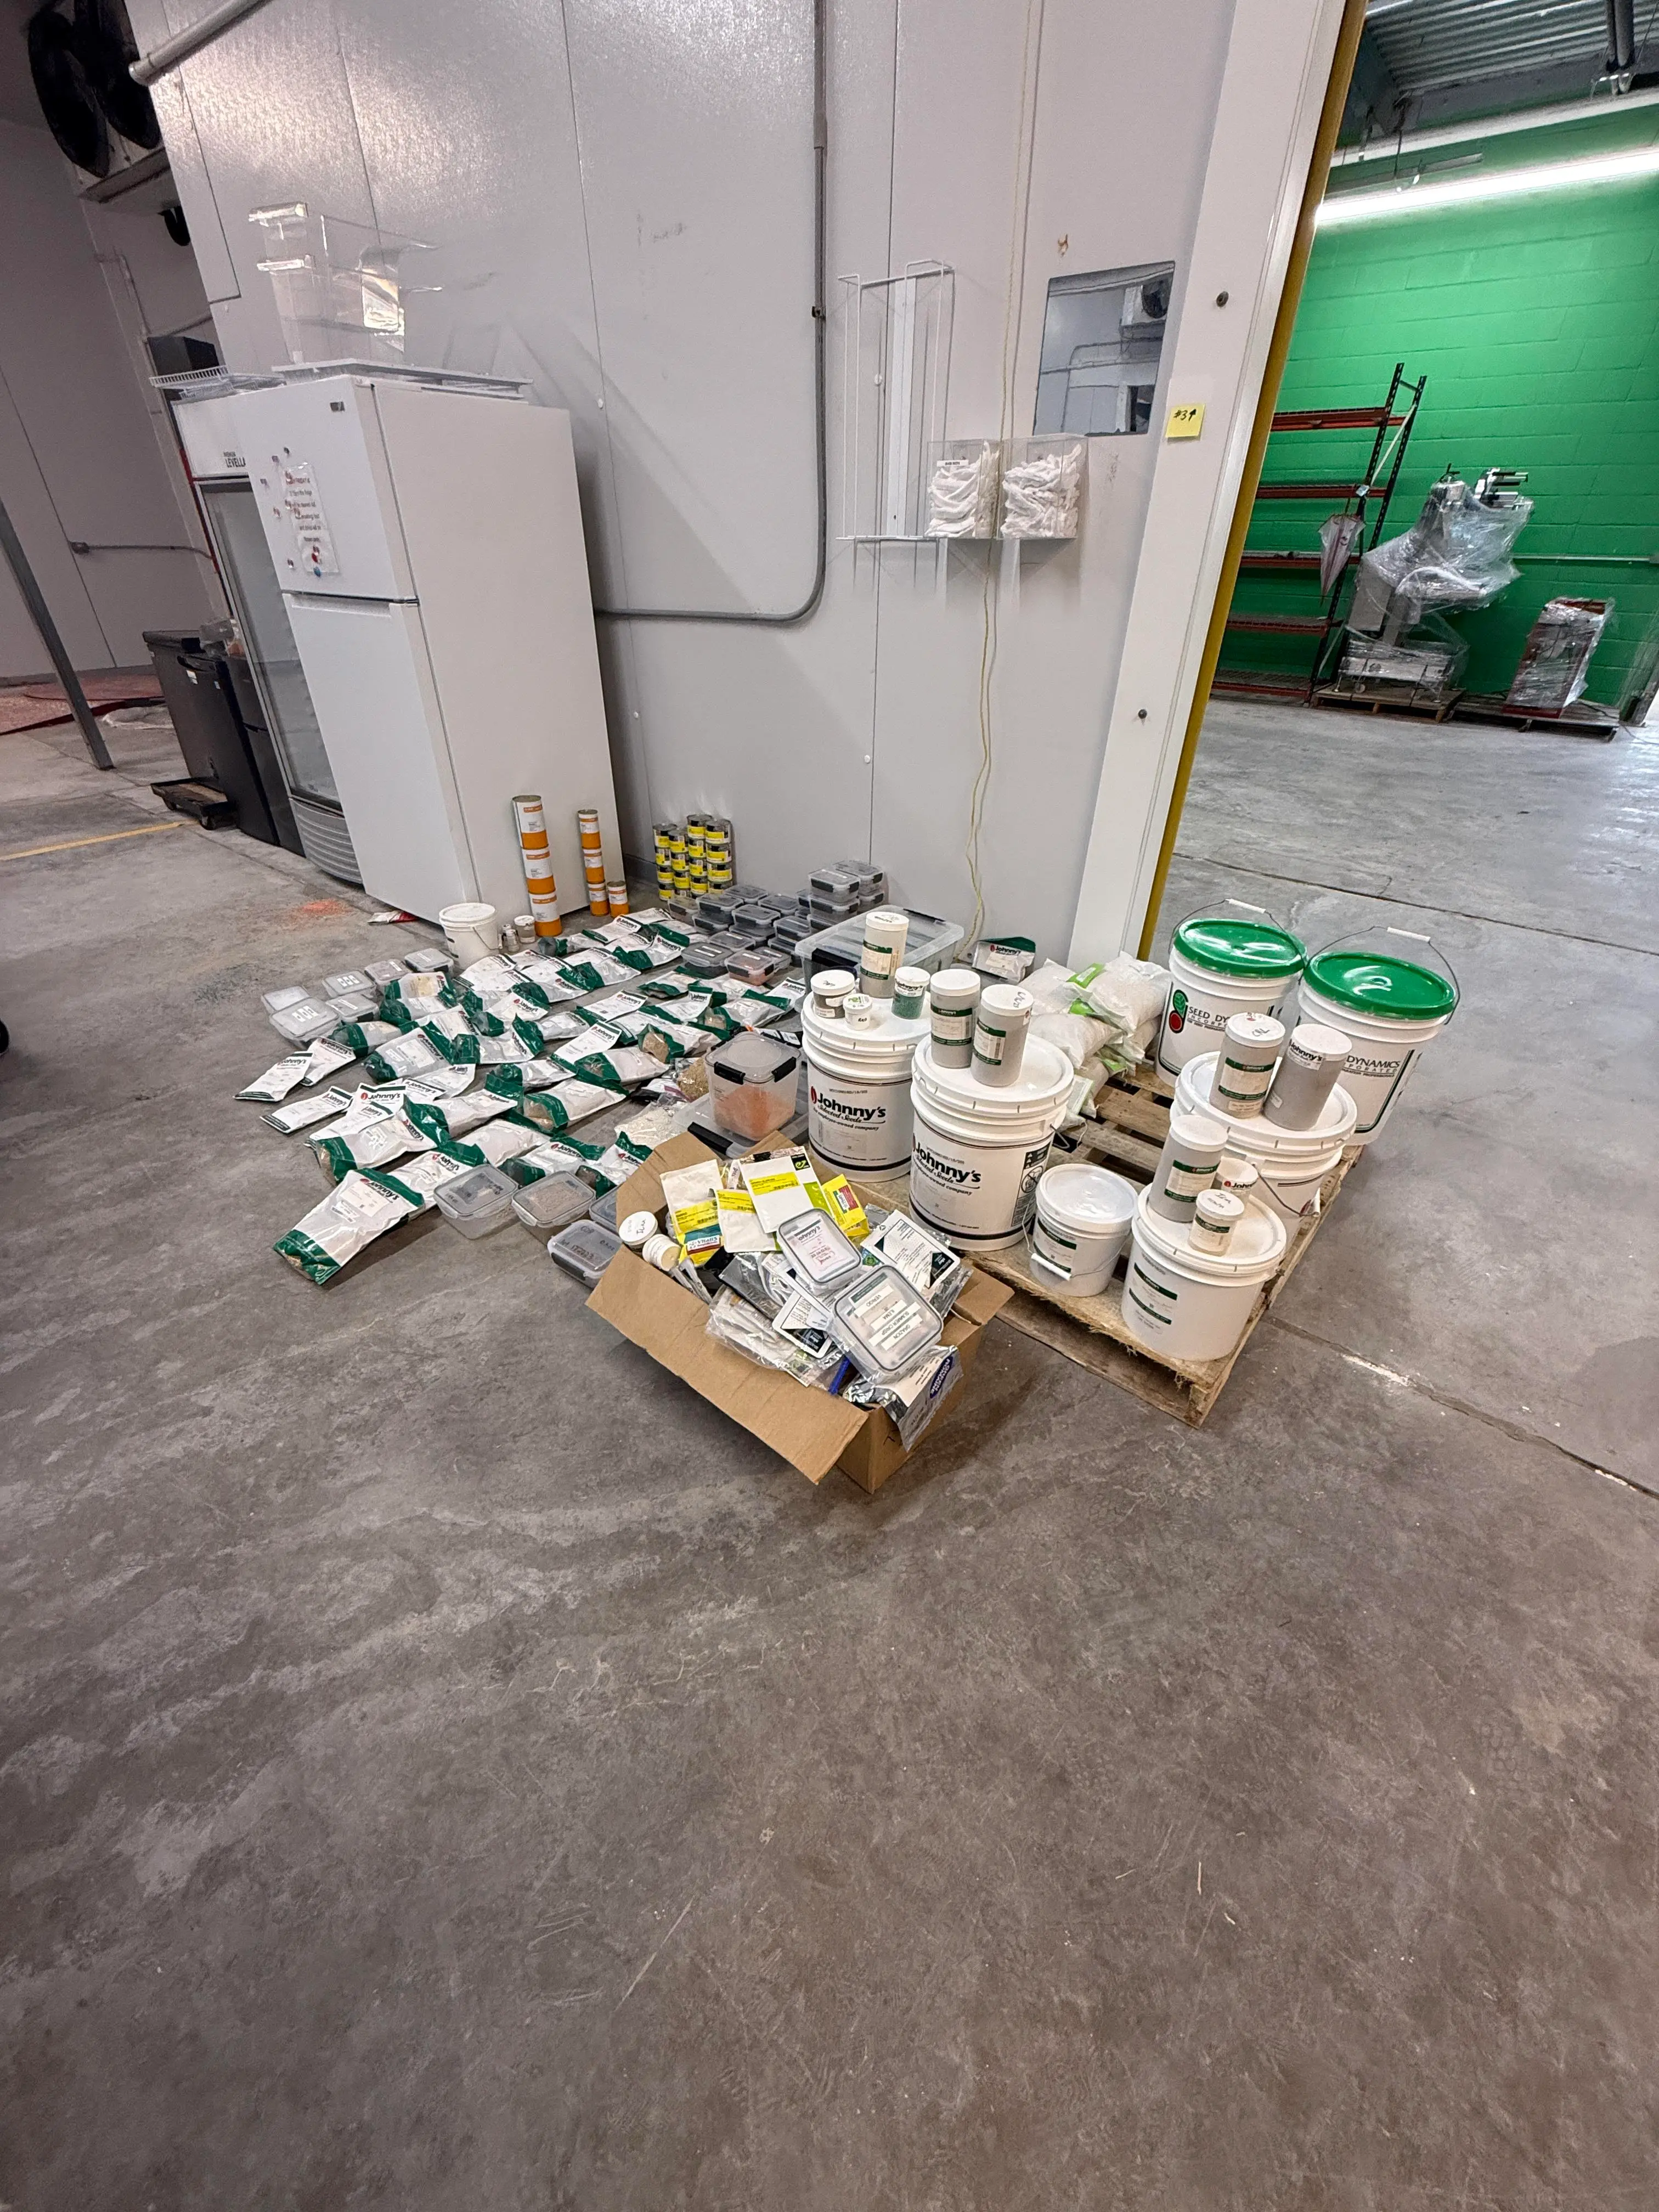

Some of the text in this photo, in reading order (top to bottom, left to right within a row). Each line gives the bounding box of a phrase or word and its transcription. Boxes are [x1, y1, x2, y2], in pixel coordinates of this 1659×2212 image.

[1173, 410, 1188, 421] #3
[1188, 1007, 1210, 1019] SEED
[1346, 1055, 1401, 1068] DYNAMICS
[817, 1092, 886, 1121] Johnny's
[916, 1142, 982, 1183] Johnny's
[946, 1185, 972, 1196] company
[882, 1311, 910, 1336] SUMMER CRISP
[930, 1358, 950, 1394] ROMAINE
